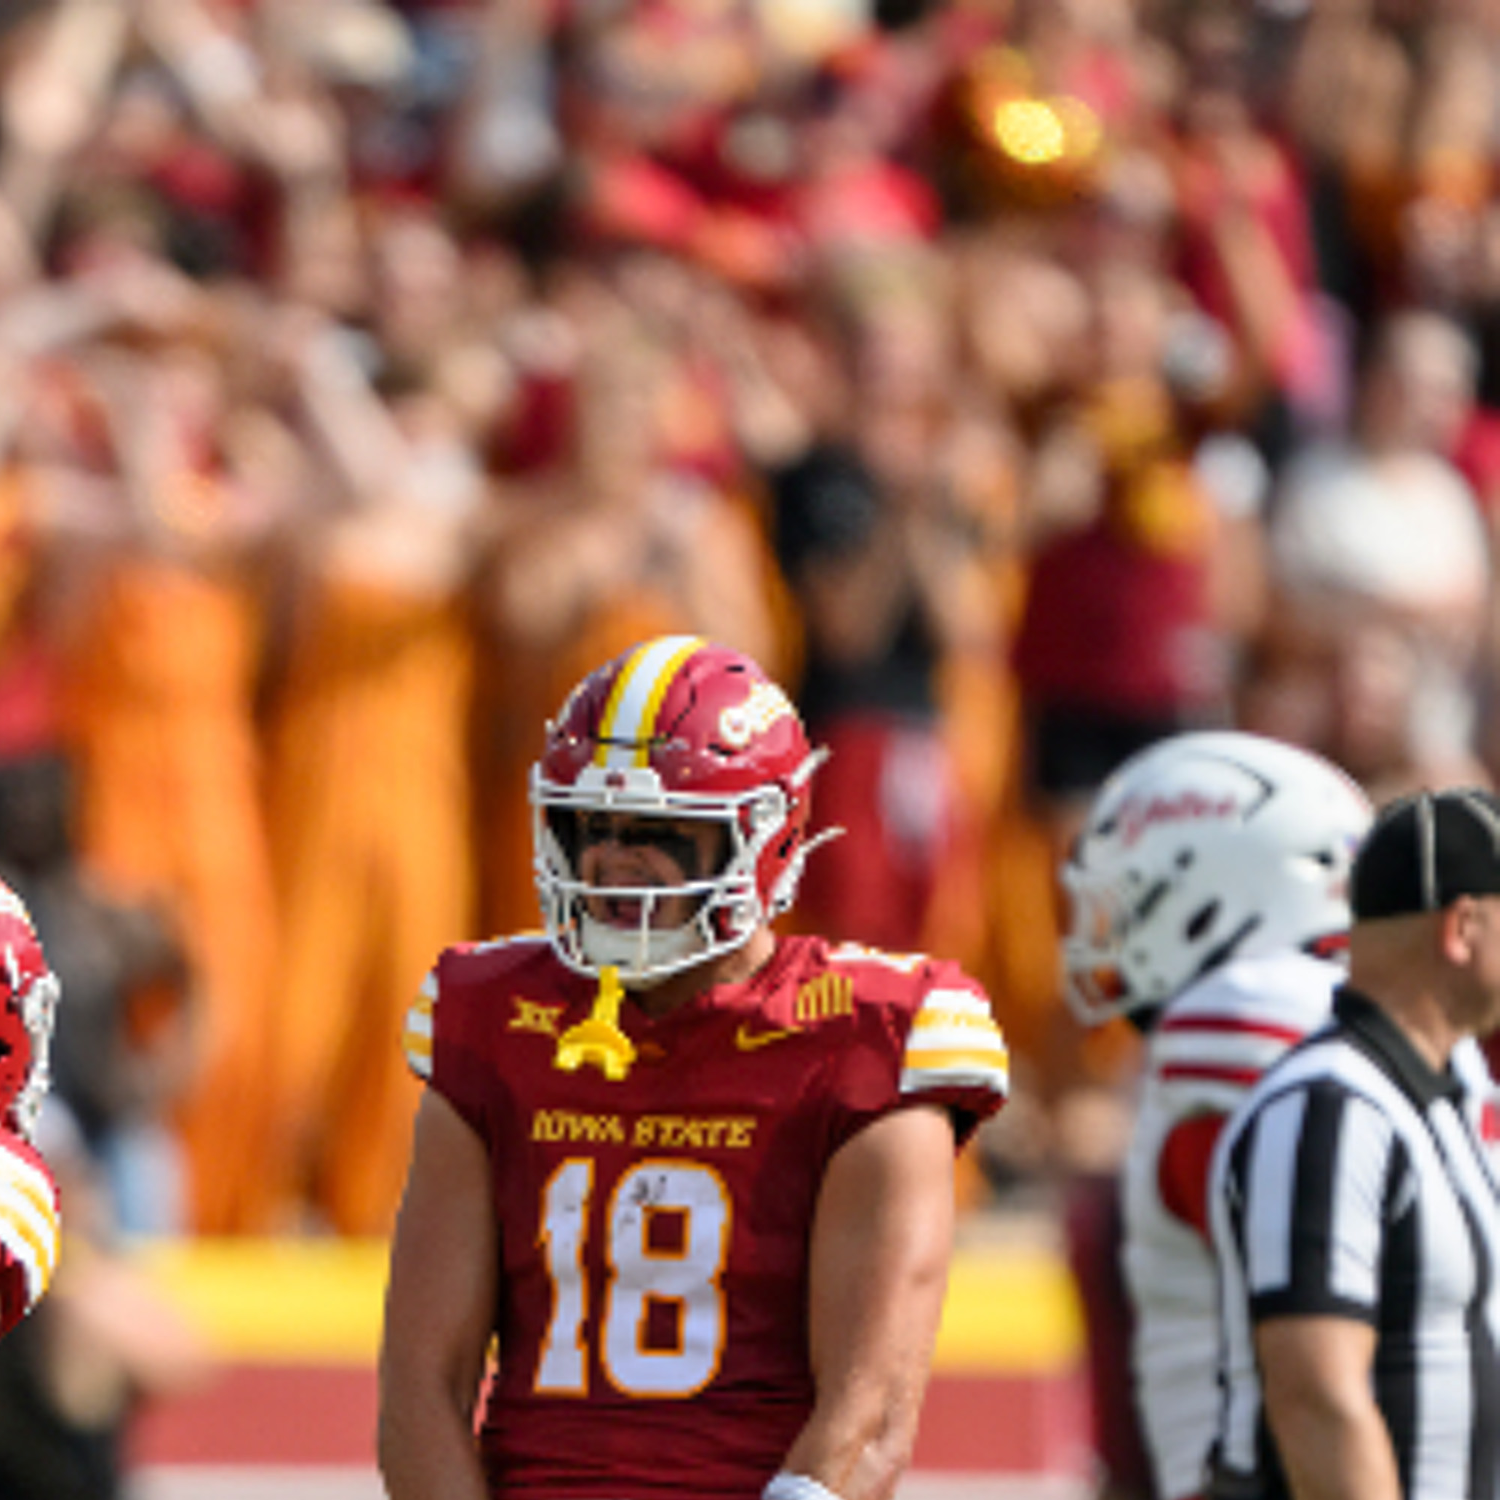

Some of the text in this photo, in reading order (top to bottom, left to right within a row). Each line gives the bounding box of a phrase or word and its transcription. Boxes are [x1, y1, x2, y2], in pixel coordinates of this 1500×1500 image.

[531, 1109, 757, 1148] IOWA STATE
[533, 1157, 734, 1400] 18
